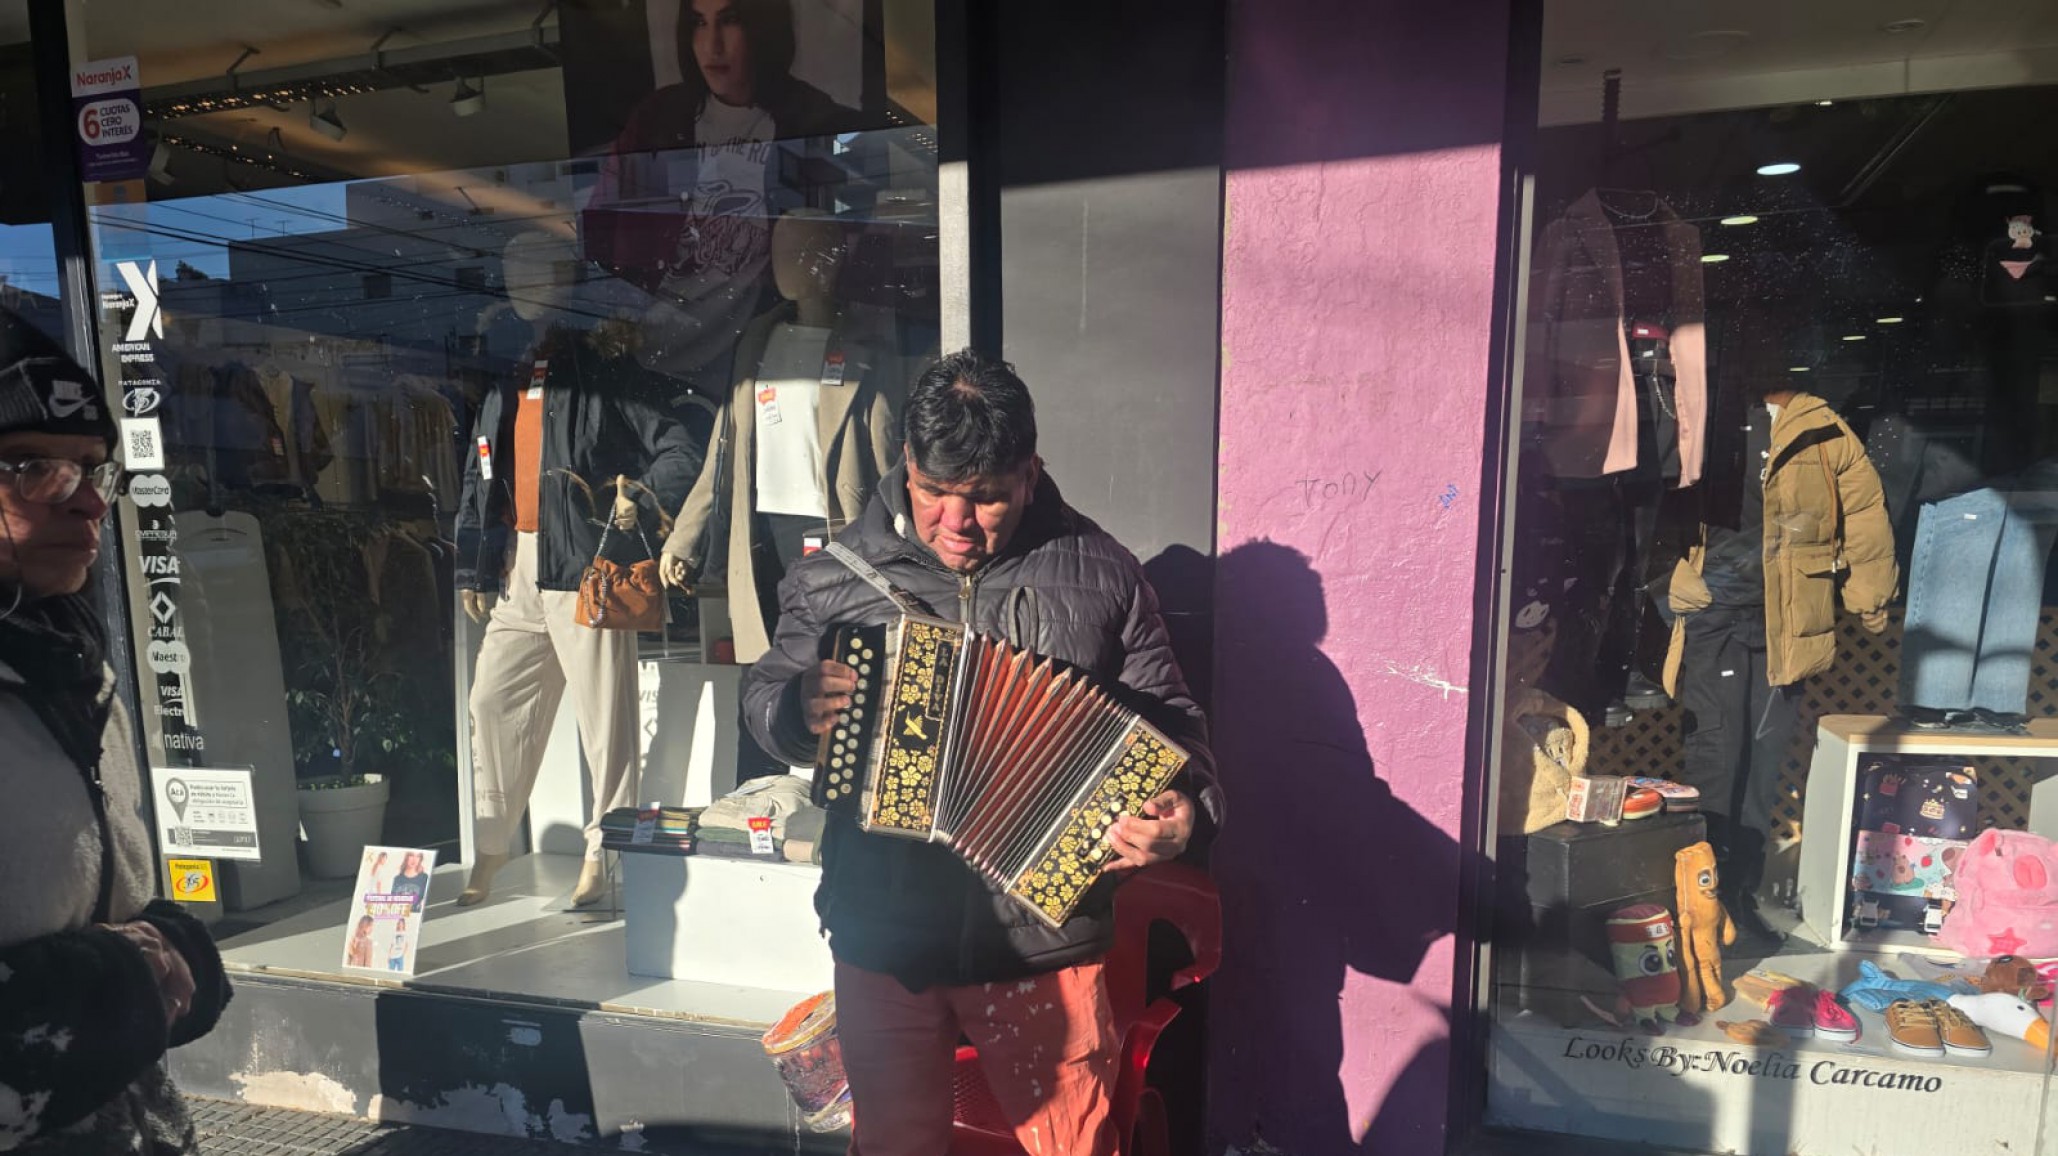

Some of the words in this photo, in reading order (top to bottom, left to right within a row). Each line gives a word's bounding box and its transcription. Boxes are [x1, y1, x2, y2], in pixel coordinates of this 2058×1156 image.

[100, 104, 131, 117] CUOTAS
[83, 108, 100, 139] 6
[101, 115, 122, 128] CERO
[138, 555, 180, 575] VISA
[147, 626, 185, 638] CABAL
[164, 732, 204, 750] nativa
[1564, 1036, 1646, 1070] Looks
[1810, 1060, 1942, 1093] Carcamo
